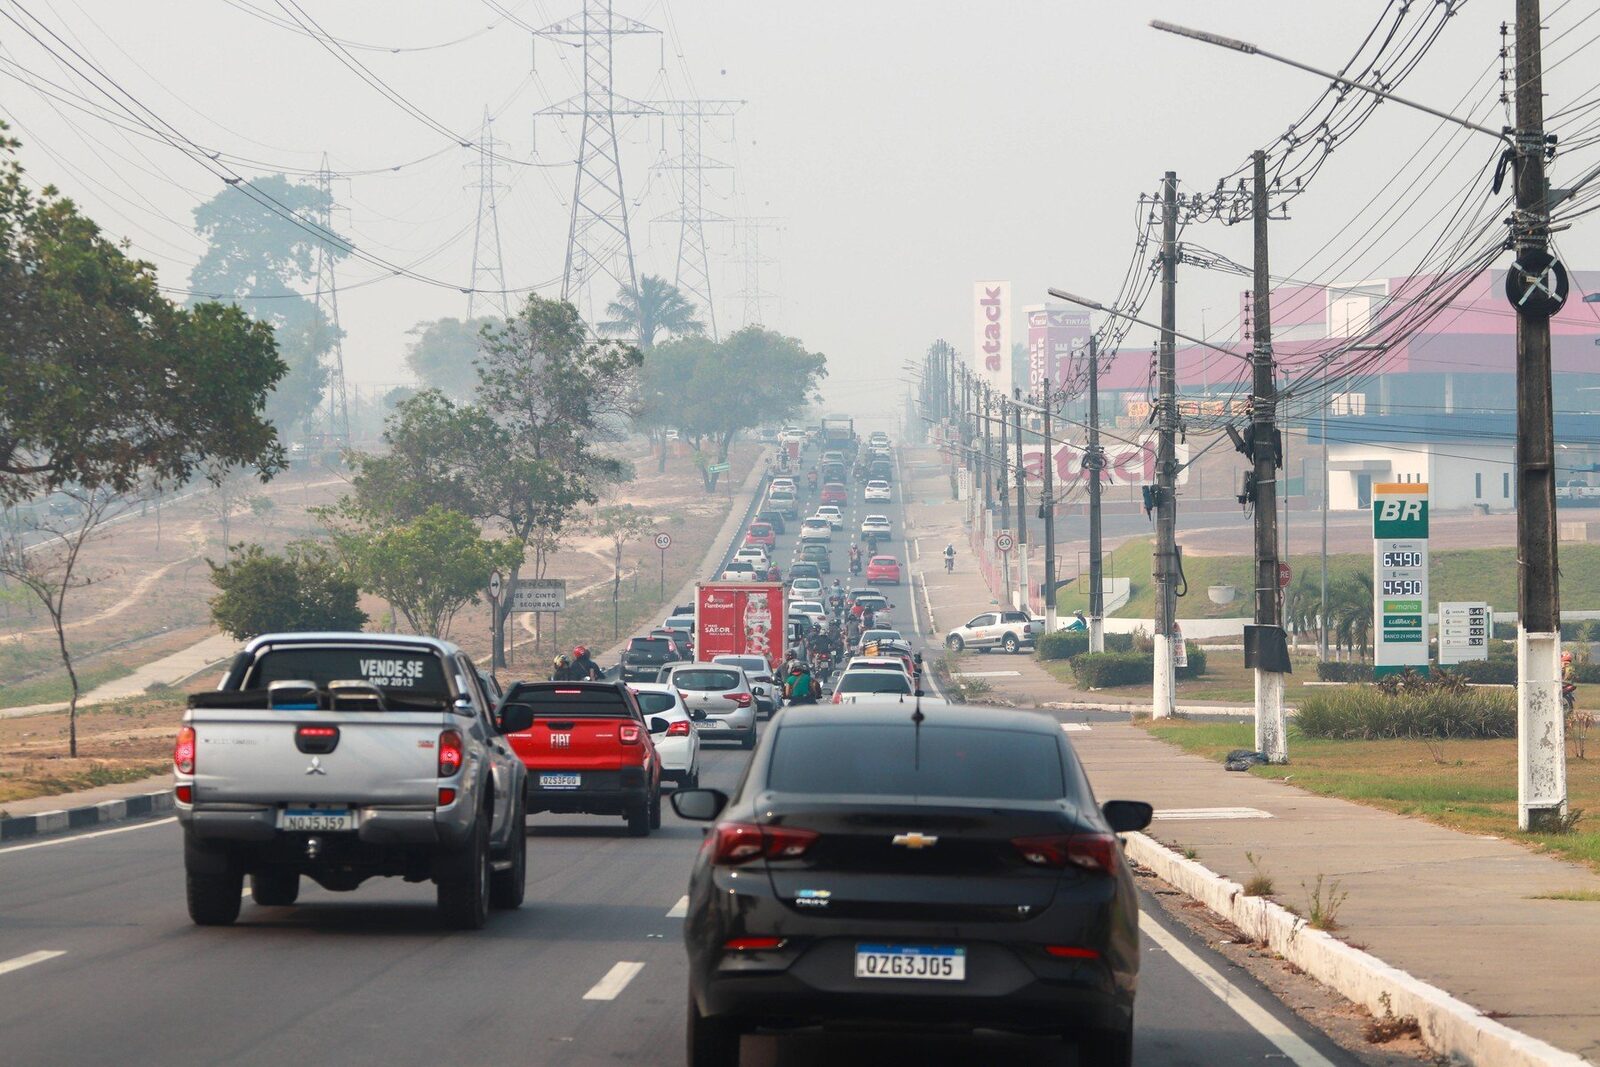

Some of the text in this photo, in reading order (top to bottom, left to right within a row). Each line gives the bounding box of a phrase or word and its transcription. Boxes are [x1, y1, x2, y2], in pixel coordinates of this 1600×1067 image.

[980, 286, 1001, 372] atack
[1379, 498, 1423, 521] BR
[657, 536, 669, 544] 60
[999, 538, 1011, 546] 60
[1383, 552, 1421, 567] 6,490
[1383, 580, 1421, 595] 4,590
[360, 659, 424, 678] VENDE-SE
[369, 677, 414, 687] ANO 2013
[550, 733, 571, 746] FIAT
[866, 955, 953, 977] QZG3J05
